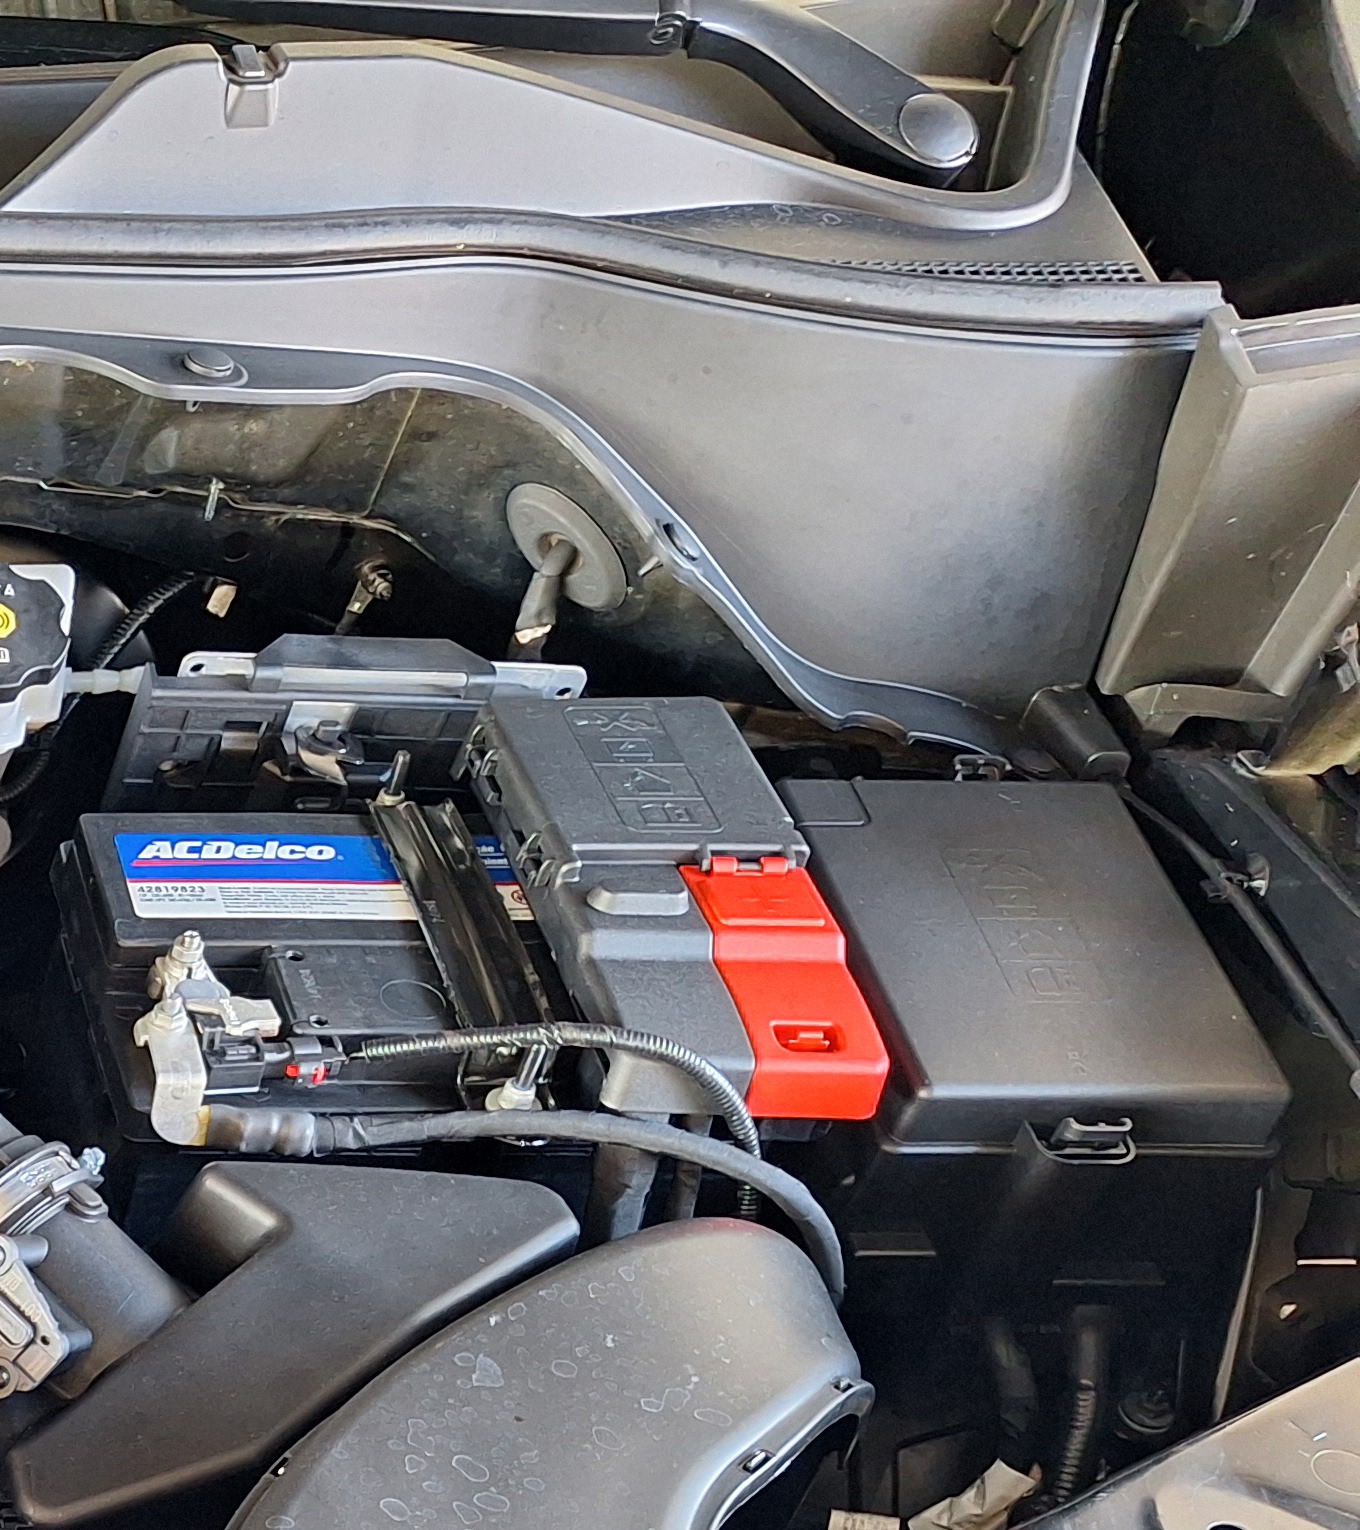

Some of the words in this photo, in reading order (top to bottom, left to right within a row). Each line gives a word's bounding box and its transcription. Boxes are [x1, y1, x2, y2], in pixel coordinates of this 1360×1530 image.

[3, 583, 15, 597] 4
[137, 840, 336, 861] ACDelco
[137, 885, 206, 893] 42819823
